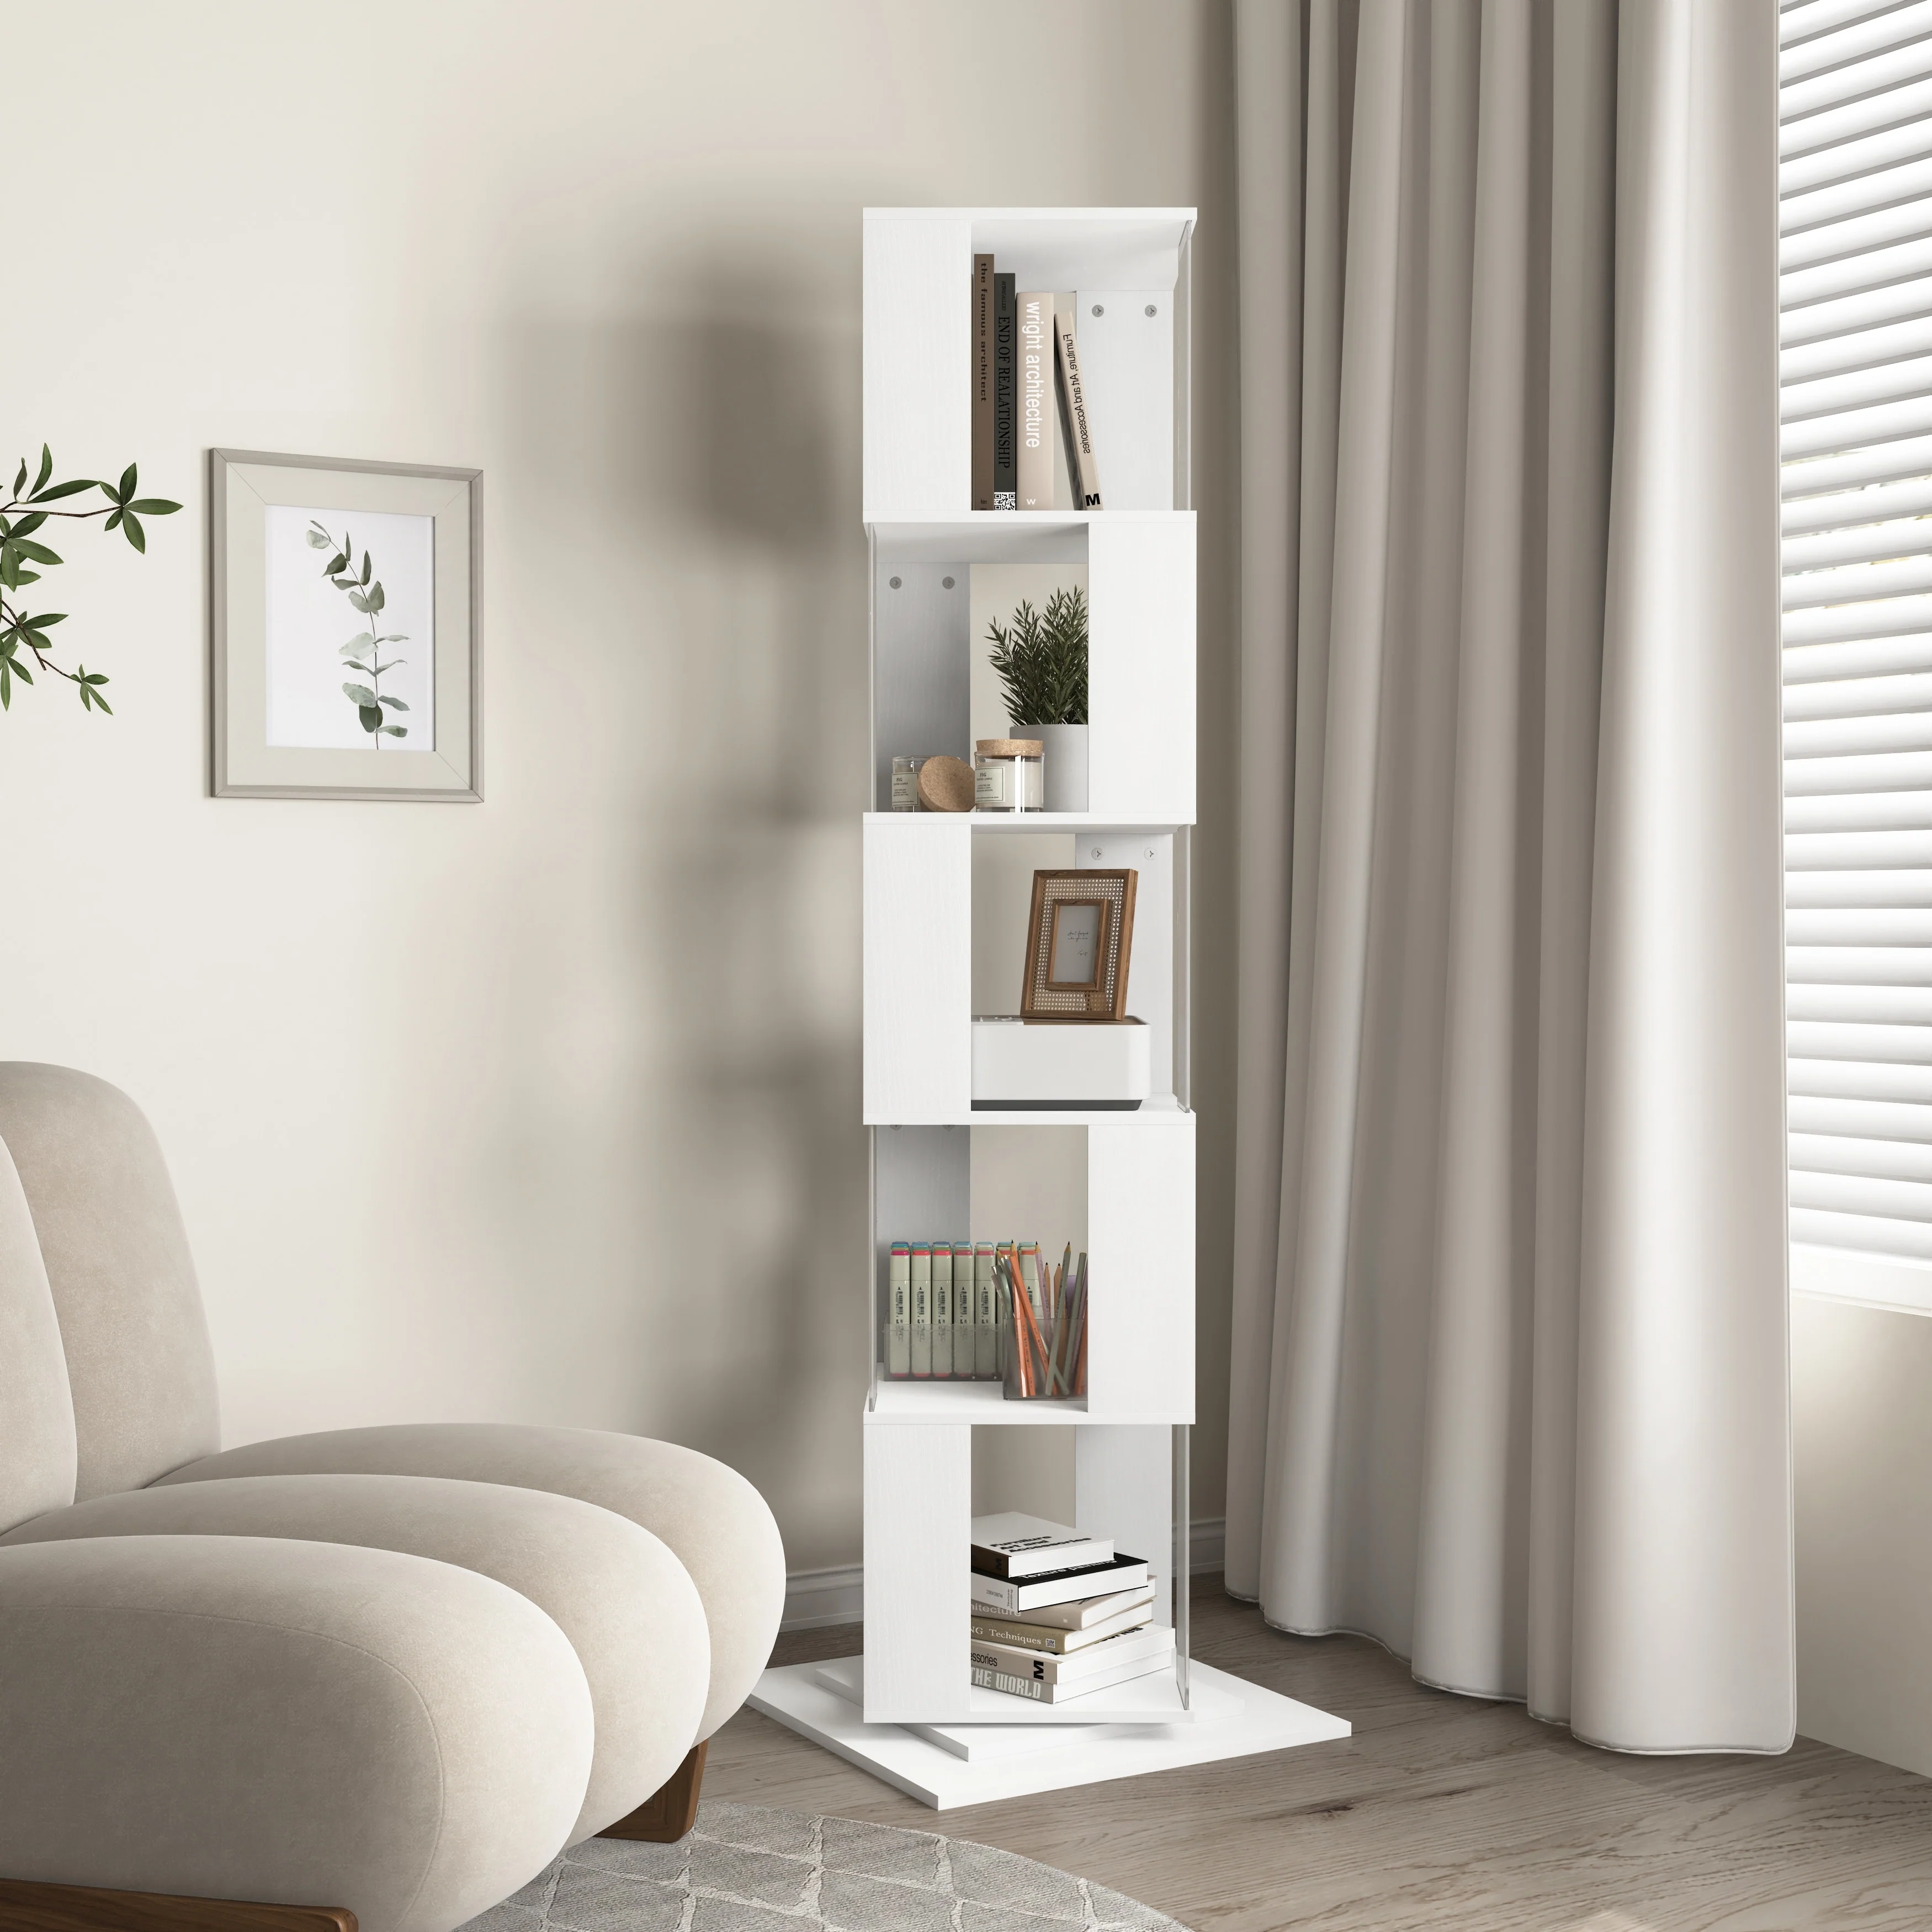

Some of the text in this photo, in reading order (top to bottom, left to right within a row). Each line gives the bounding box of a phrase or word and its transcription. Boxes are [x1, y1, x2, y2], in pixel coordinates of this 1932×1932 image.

[1022, 301, 1044, 448] wright architecture
[998, 316, 1010, 468] END OF REALATIONSHIP
[1085, 493, 1101, 506] M
[990, 1536, 1052, 1547] Furniture
[1009, 1537, 1092, 1552] Accessories
[989, 1628, 1041, 1644] Techniques
[1033, 1660, 1044, 1680] M
[995, 1673, 1041, 1699] WORLD
